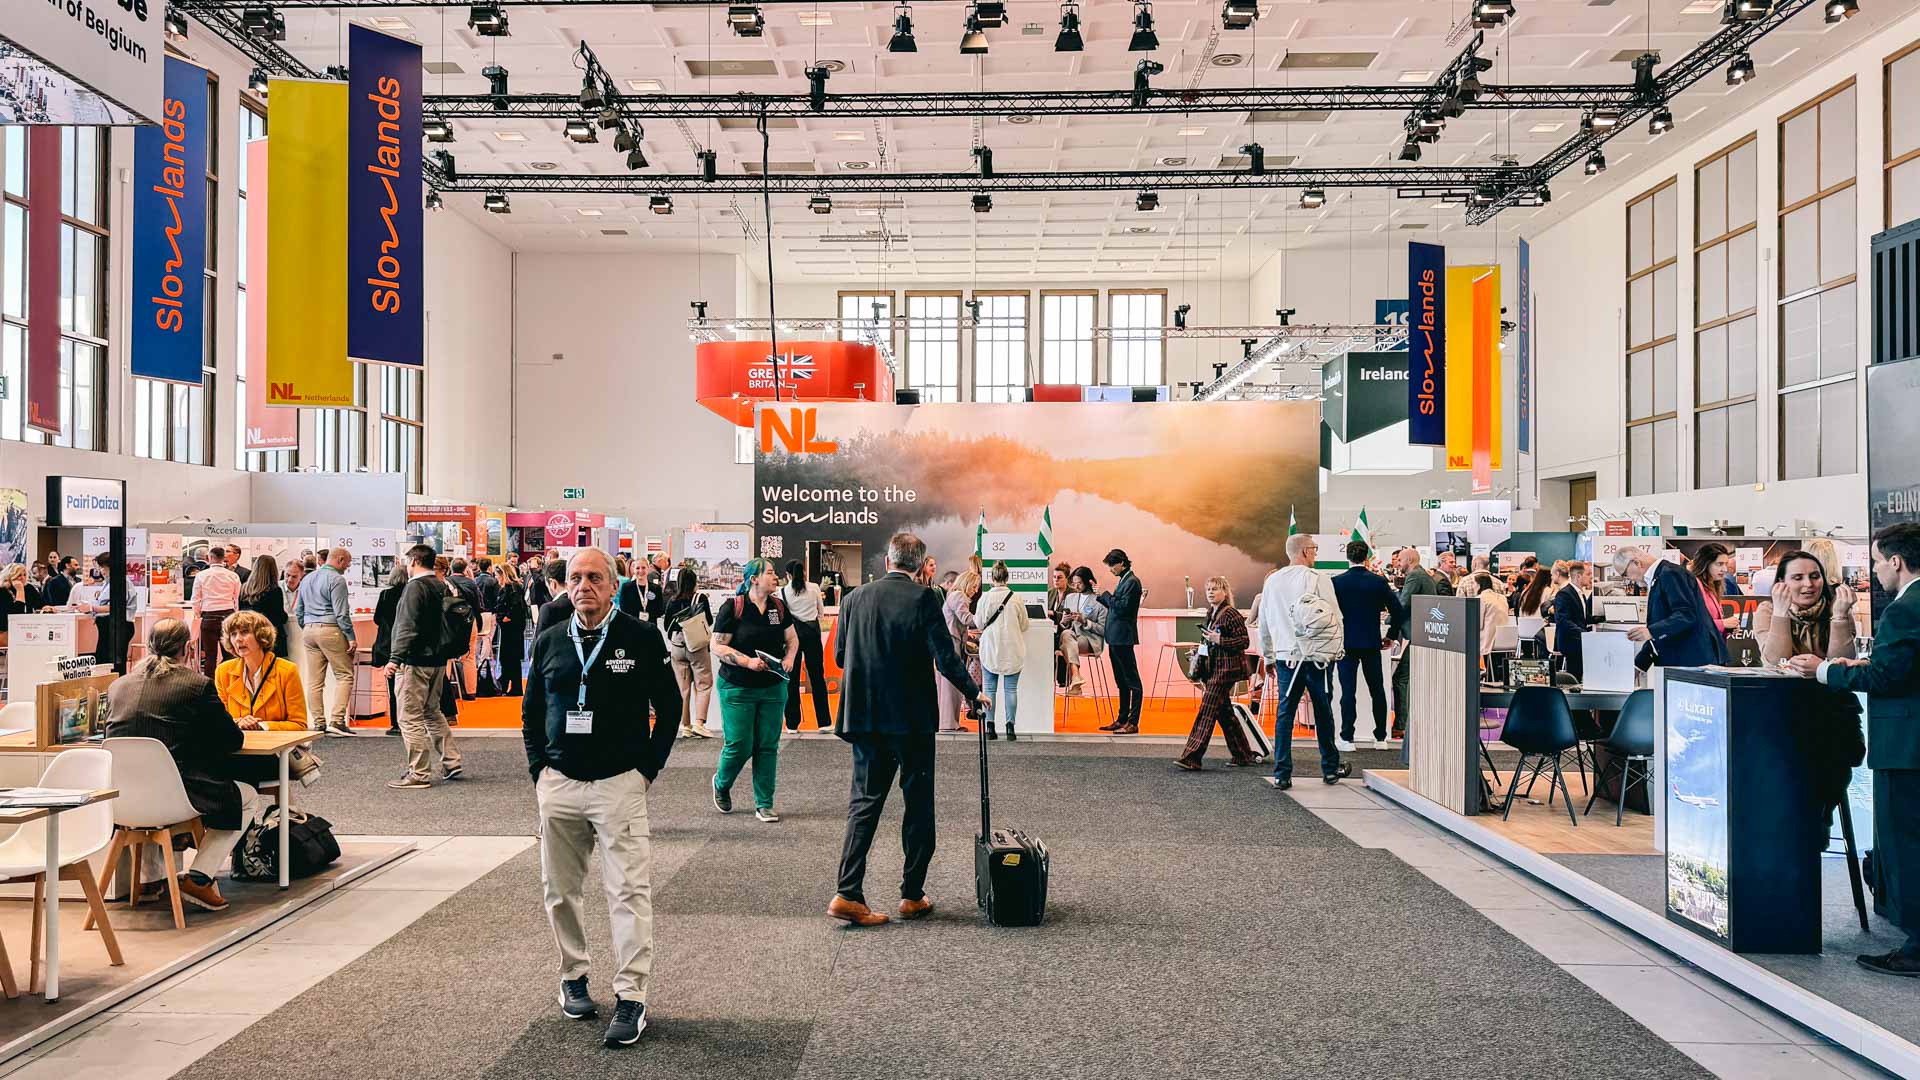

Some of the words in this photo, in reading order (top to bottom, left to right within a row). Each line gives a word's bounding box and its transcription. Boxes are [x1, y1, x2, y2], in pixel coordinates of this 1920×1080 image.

[66, 0, 82, 21] of
[85, 7, 147, 63] Belgium
[367, 76, 401, 314] Slowlands
[1417, 268, 1435, 415] Slowlands
[748, 380, 786, 389] BRITAN
[270, 382, 302, 400] NL
[304, 394, 350, 402] Netherlands
[247, 427, 266, 444] NL
[761, 407, 839, 453] NL
[1449, 456, 1469, 467] NL
[762, 484, 853, 502] Welcome
[858, 486, 879, 502] to
[883, 484, 917, 502] the
[67, 494, 90, 509] Pairi
[91, 495, 119, 510] Daiza
[762, 506, 879, 525] Slowlands
[1440, 513, 1468, 525] Abbey
[1480, 515, 1507, 525] Abbey
[210, 526, 248, 536] AccesRail
[93, 537, 106, 546] 38
[339, 538, 353, 548] 36
[372, 538, 386, 548] 35
[694, 540, 707, 550] 34
[726, 540, 740, 550] 33
[992, 542, 1006, 551] 32
[1026, 542, 1037, 551] 31
[1603, 544, 1617, 554] 28
[987, 571, 1044, 580] RERDAM
[1424, 621, 1450, 635] MONDORF
[57, 657, 96, 672] INCOMING
[63, 669, 92, 680] Wallonia
[1685, 698, 1714, 716] Luxair
